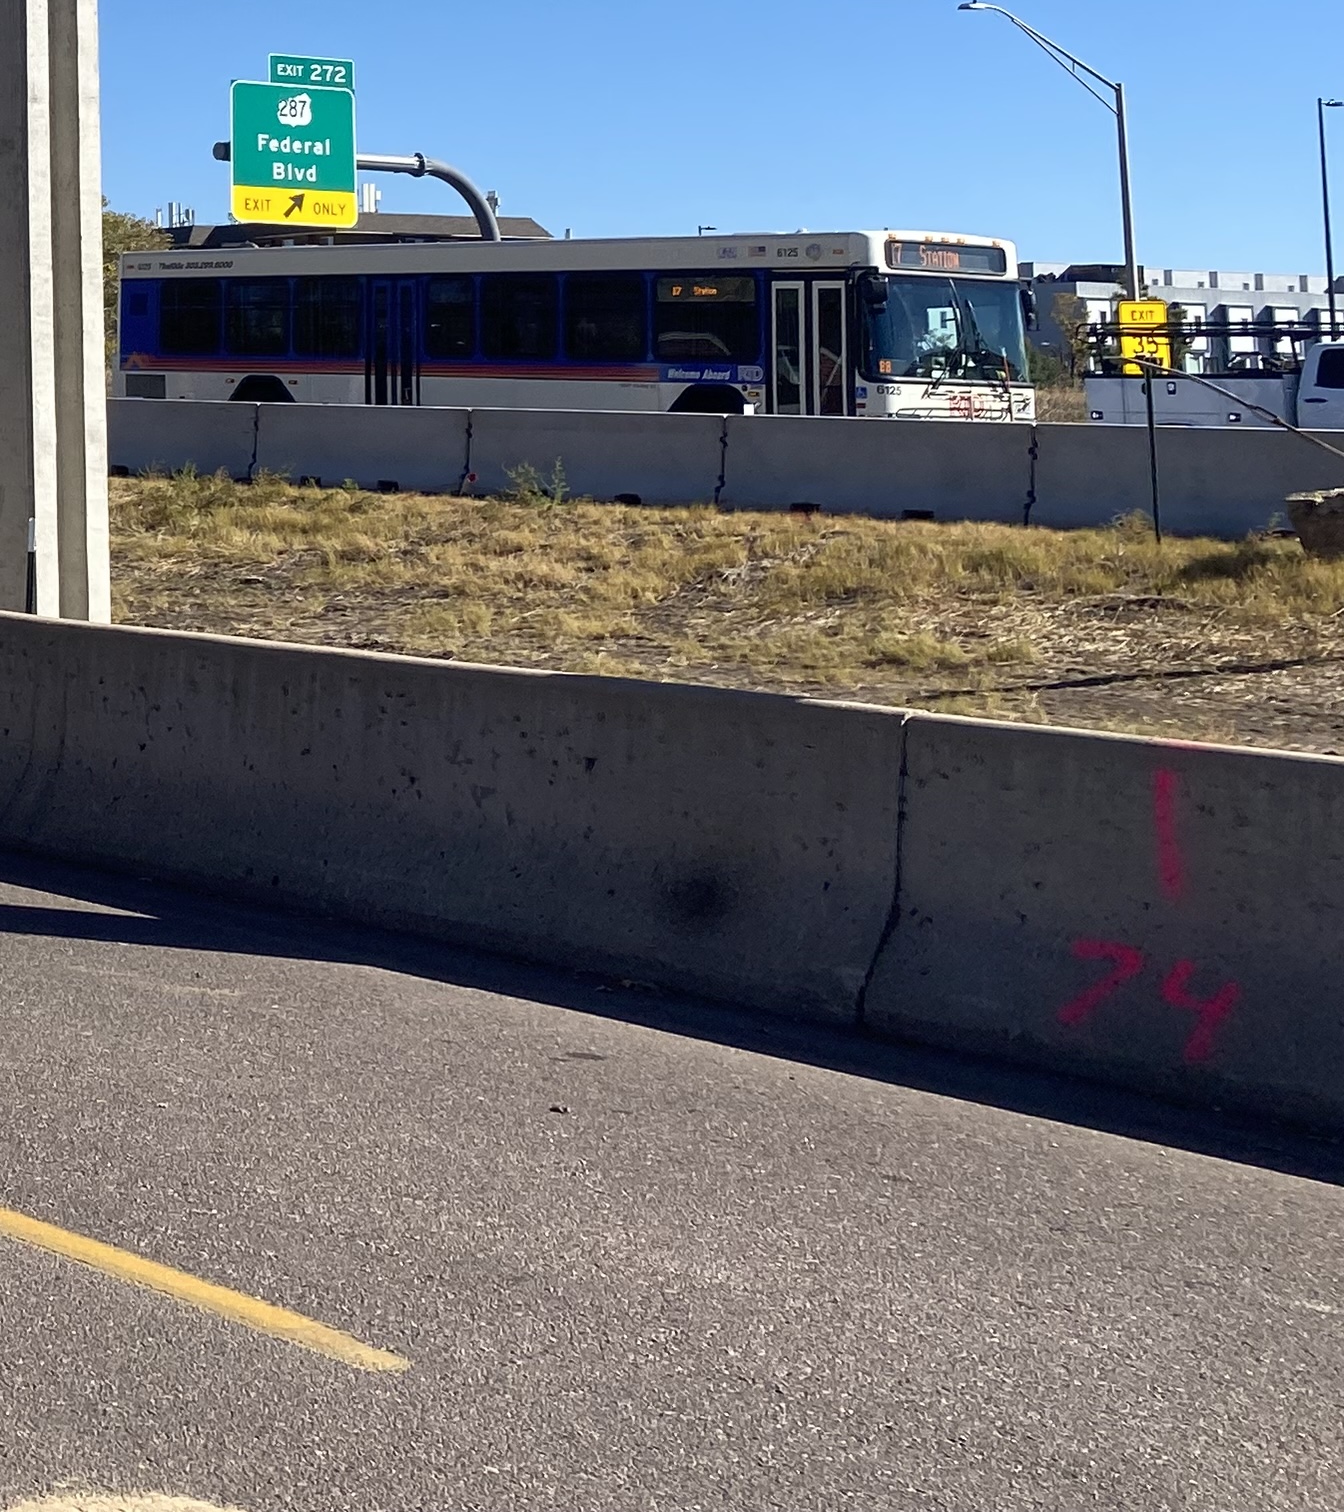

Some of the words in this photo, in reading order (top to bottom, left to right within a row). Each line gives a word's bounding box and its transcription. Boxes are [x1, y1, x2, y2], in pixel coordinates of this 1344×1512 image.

[277, 63, 304, 77] EXIT
[310, 64, 346, 83] 272
[279, 100, 307, 118] 287
[257, 134, 331, 156] Federal
[272, 162, 317, 182] Blvd
[244, 197, 272, 212] EXIT
[313, 201, 346, 216] ONLY
[777, 247, 799, 258] 6125
[1130, 310, 1155, 321] EXIT
[1133, 336, 1158, 354] 35
[667, 368, 701, 379] Welcome
[701, 369, 732, 380] Aboard
[876, 385, 902, 396] 6125
[1055, 936, 1243, 1065] 74
